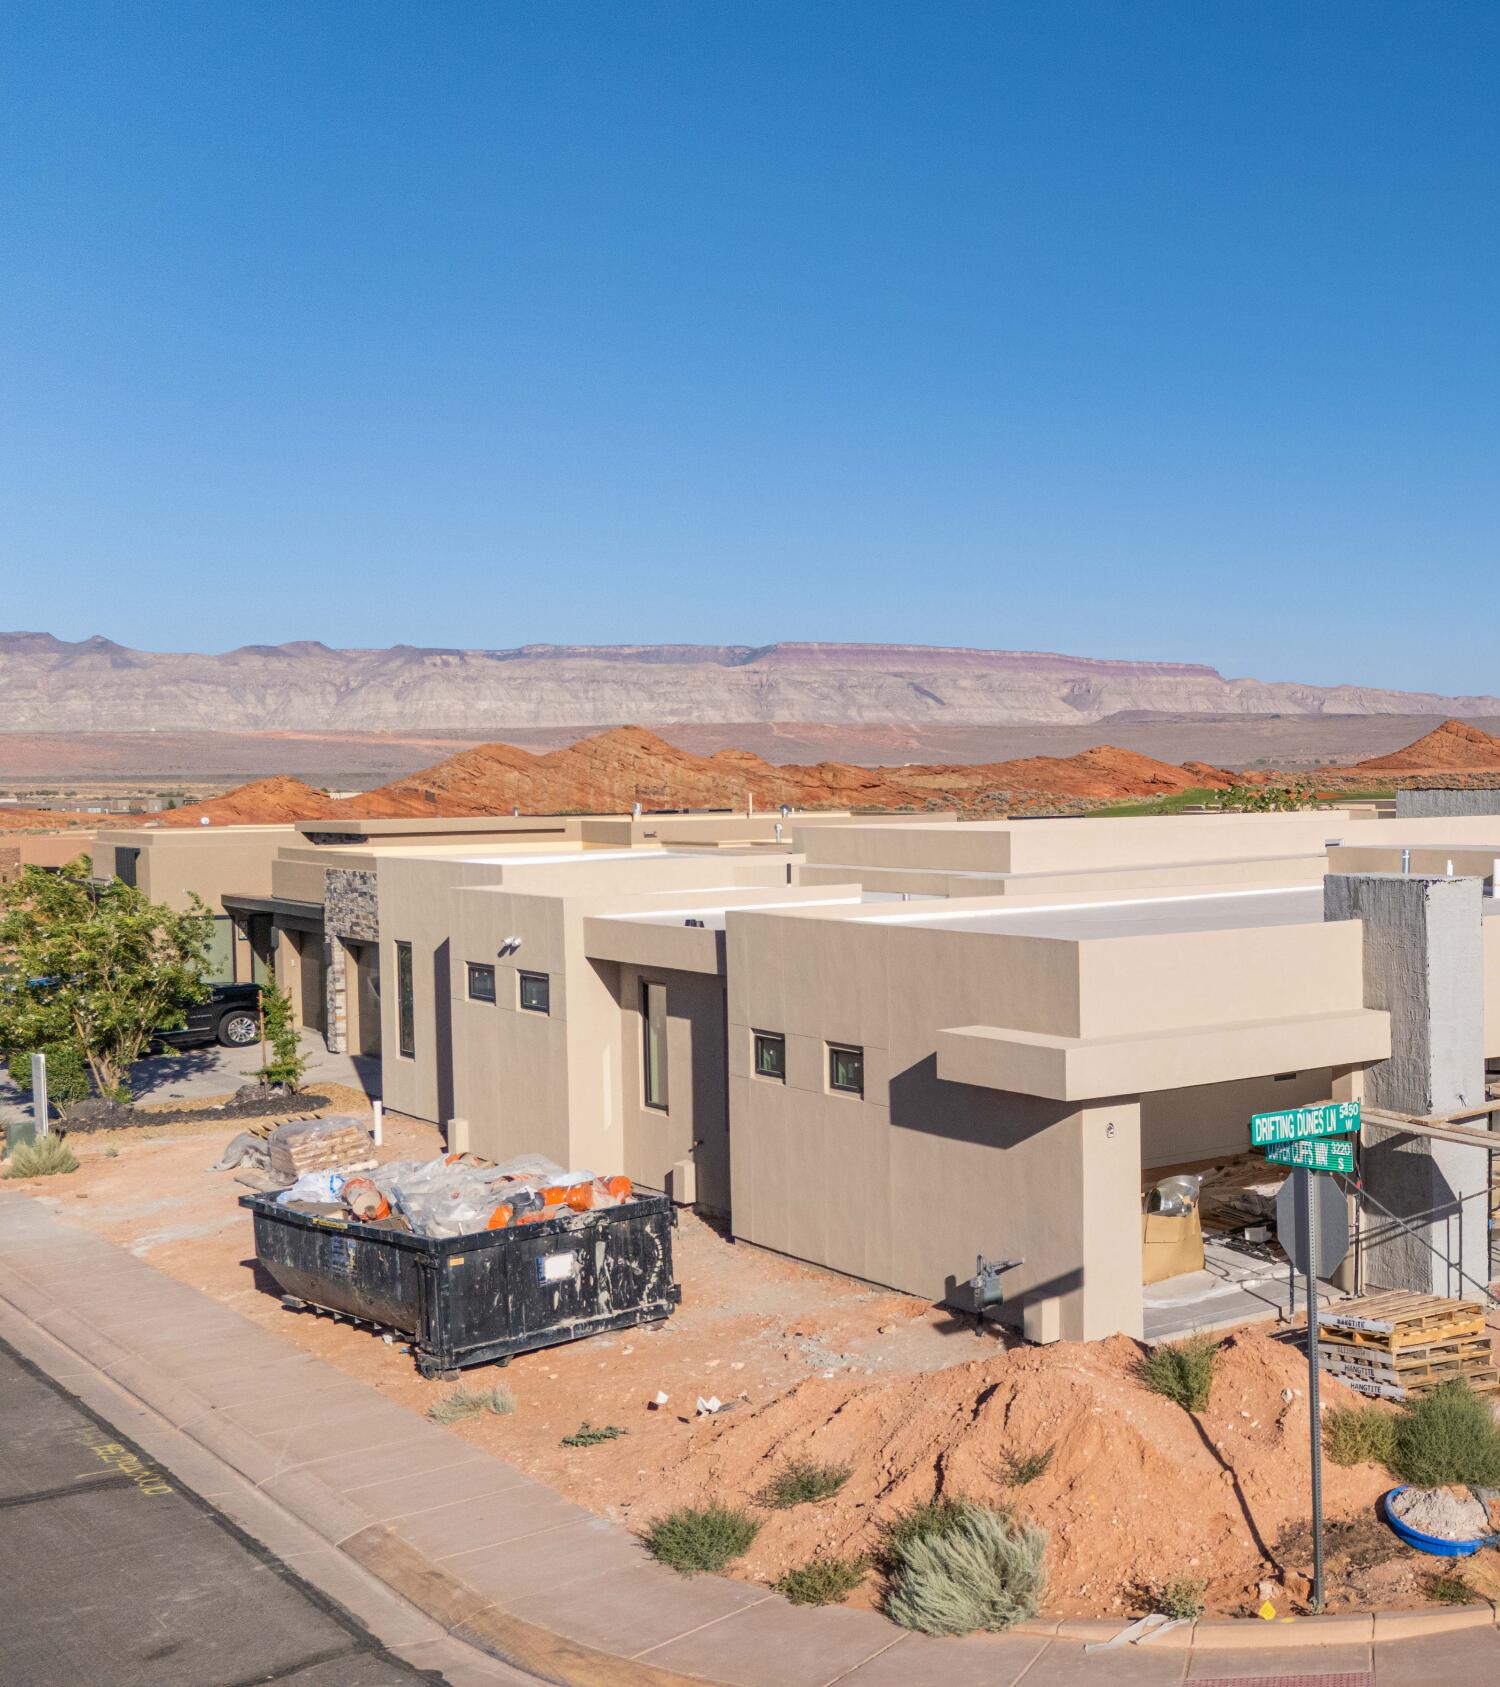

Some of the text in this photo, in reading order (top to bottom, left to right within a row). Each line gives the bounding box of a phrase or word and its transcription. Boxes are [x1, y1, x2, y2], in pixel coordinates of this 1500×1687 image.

[1255, 1103, 1359, 1142] DRIFTING DUNES LN 5450
[1345, 1118, 1353, 1131] W
[1291, 1140, 1314, 1165] CLIFFS
[1314, 1142, 1329, 1166] WAY
[1331, 1142, 1351, 1155] 3220
[1337, 1157, 1345, 1170] S
[1344, 1364, 1375, 1377] HANGTITE
[1350, 1382, 1382, 1394] HANGTITE
